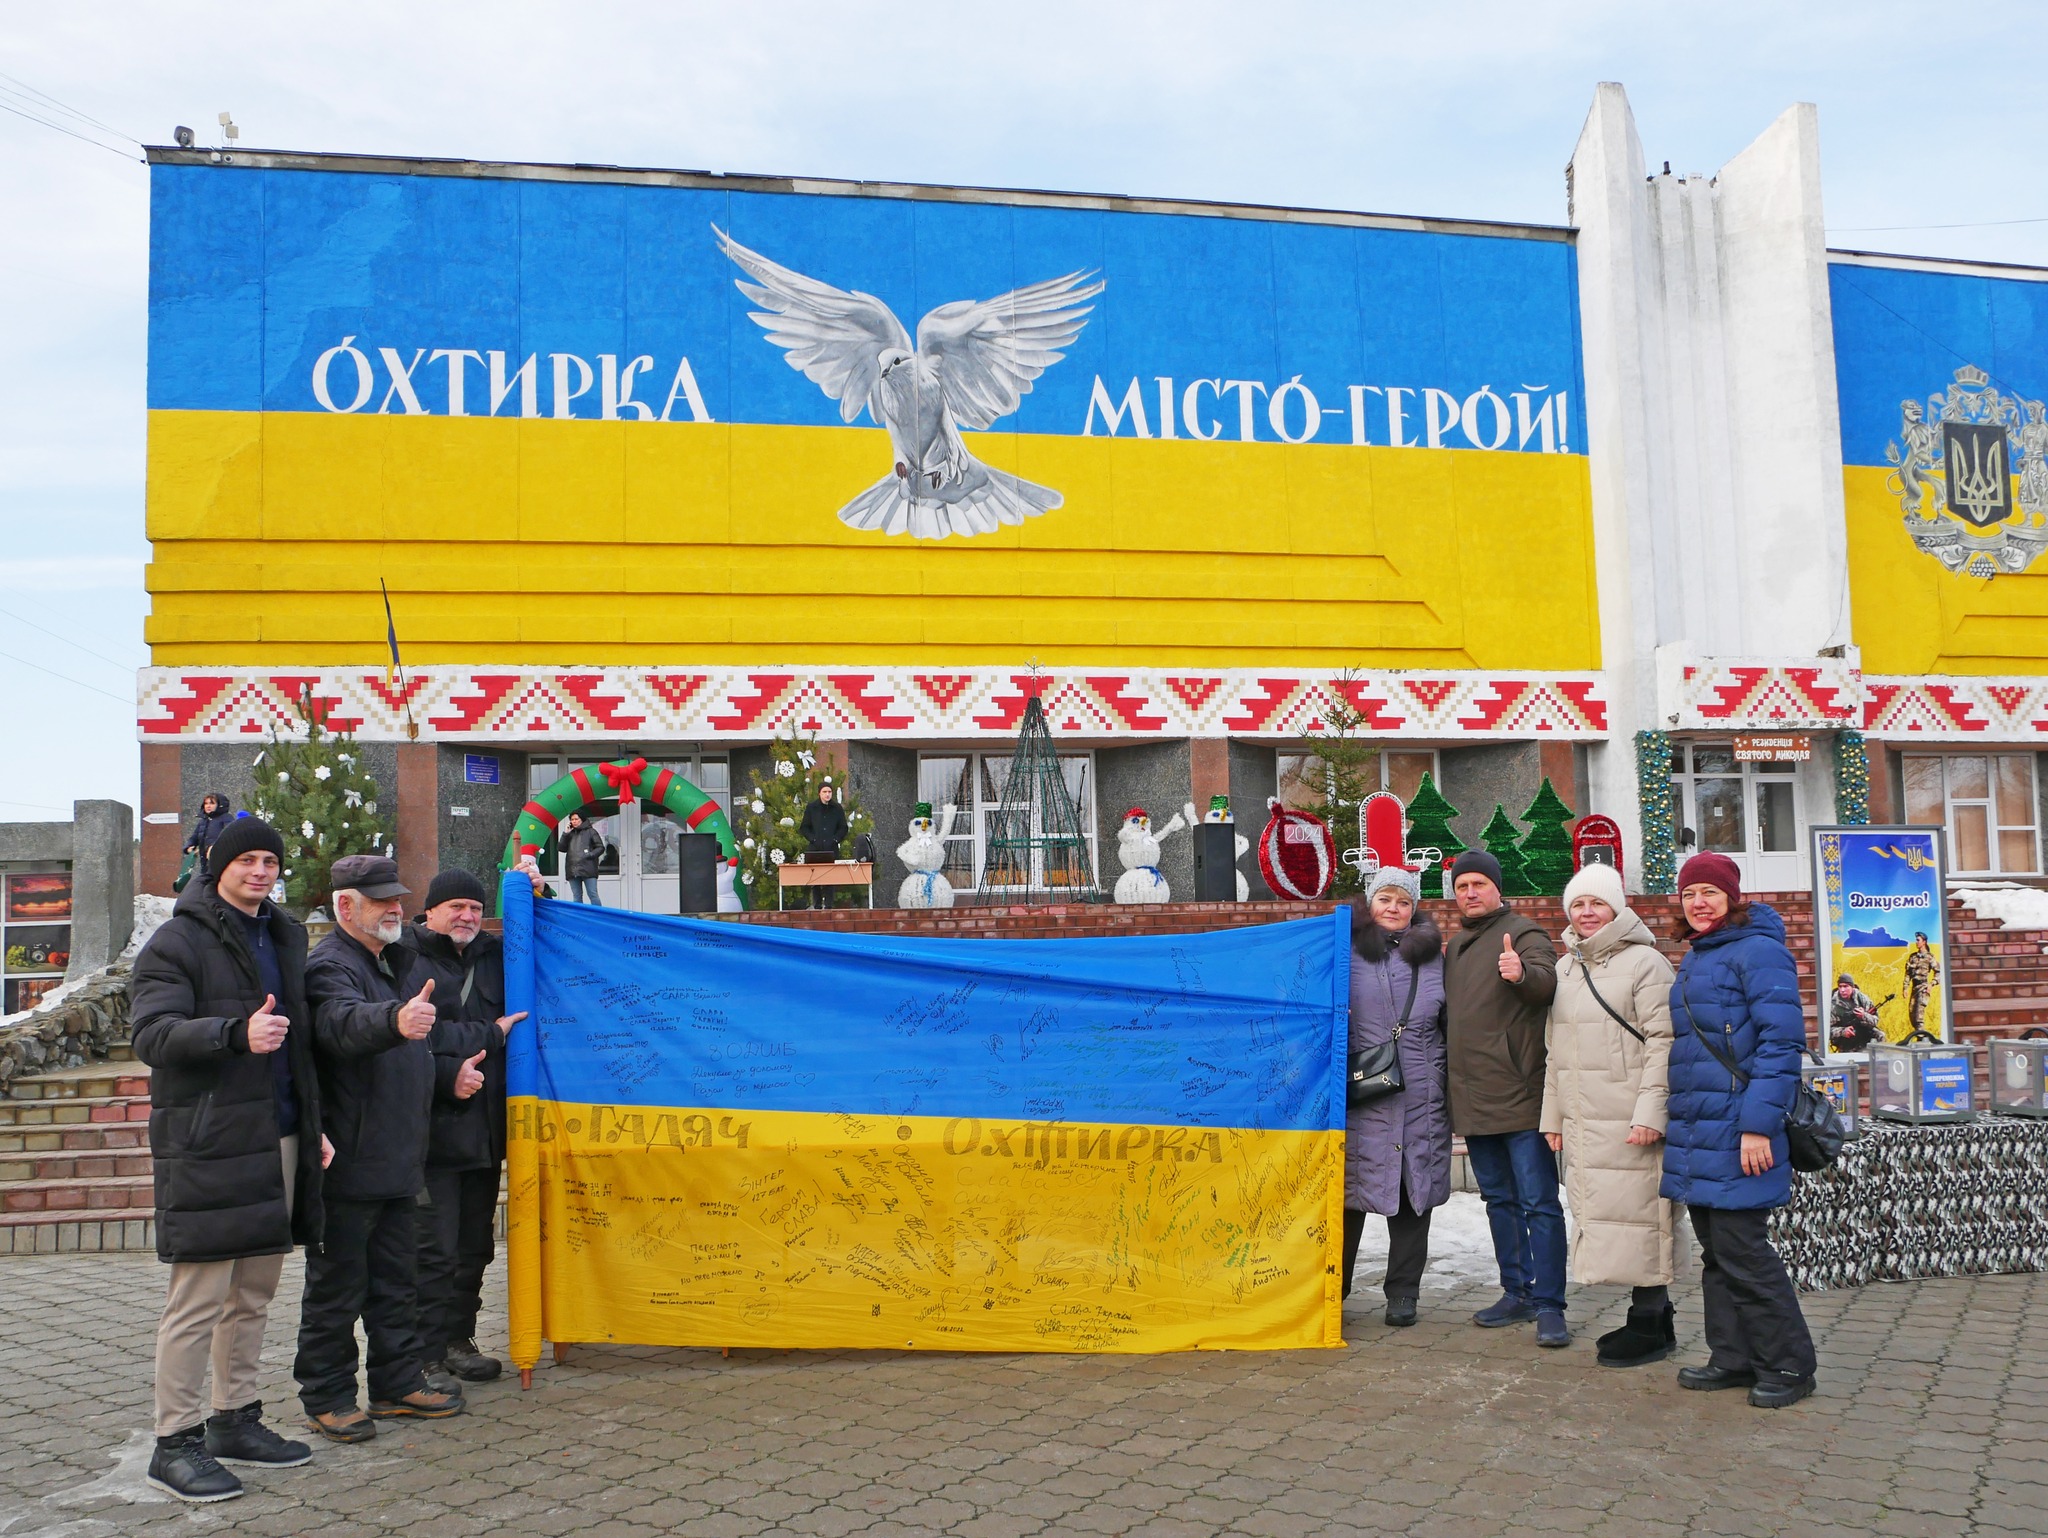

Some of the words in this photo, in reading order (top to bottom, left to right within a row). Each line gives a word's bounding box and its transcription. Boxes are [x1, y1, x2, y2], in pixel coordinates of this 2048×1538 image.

[1751, 738, 1793, 748] РЕЗИДЕНЦІЯ
[1735, 750, 1773, 760] СВЯТОГО
[1775, 750, 1811, 761] МИКОЛАЯ
[1285, 826, 1323, 843] 2024
[1593, 853, 1601, 863] 3
[1849, 891, 1930, 912] Дякуємо!
[690, 1242, 740, 1254] Перемога
[1049, 1303, 1092, 1316] Слава
